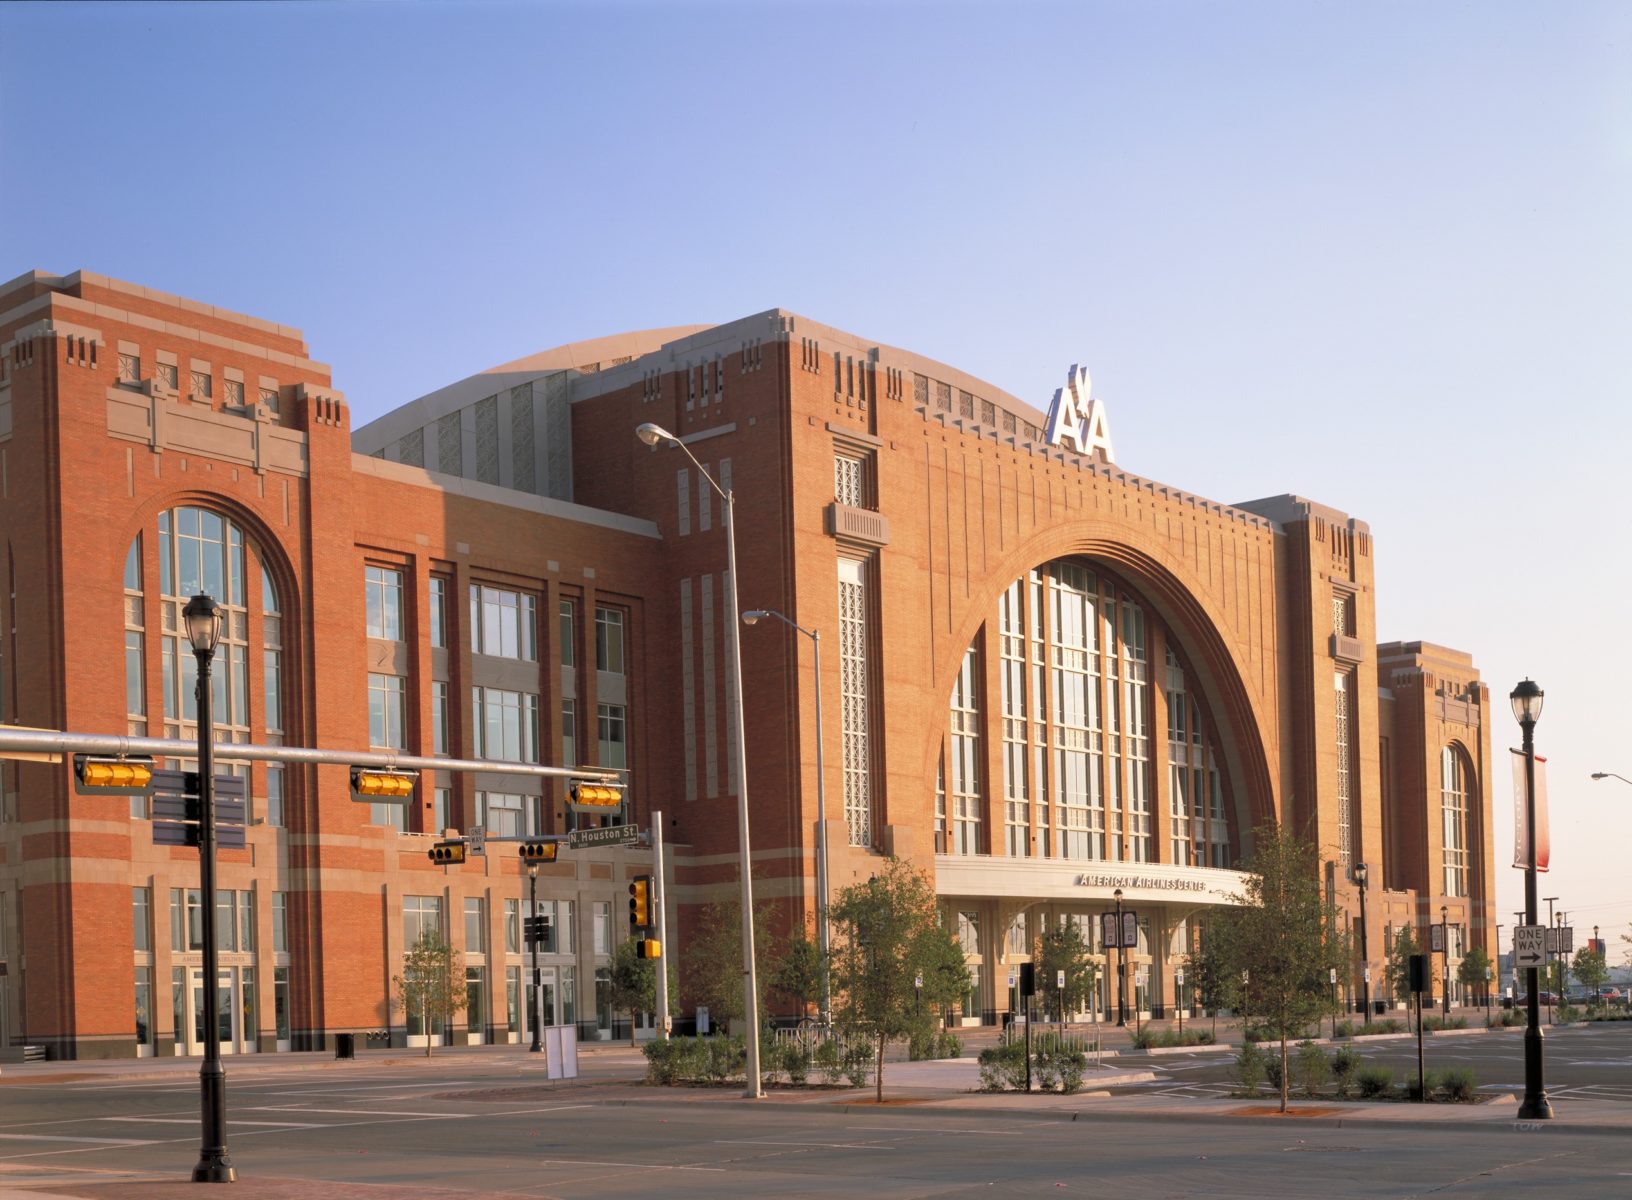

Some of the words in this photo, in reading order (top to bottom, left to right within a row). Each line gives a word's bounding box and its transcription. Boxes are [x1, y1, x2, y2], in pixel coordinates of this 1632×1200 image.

[1047, 386, 1116, 463] AA
[570, 834, 580, 843] N.
[581, 829, 620, 842] Houston
[623, 827, 637, 837] St.
[1080, 874, 1133, 888] AMERICAN
[1136, 877, 1176, 890] AIRLINES
[1178, 880, 1207, 891] CENTER
[1518, 929, 1541, 939] ONE
[1518, 940, 1543, 950] WAY
